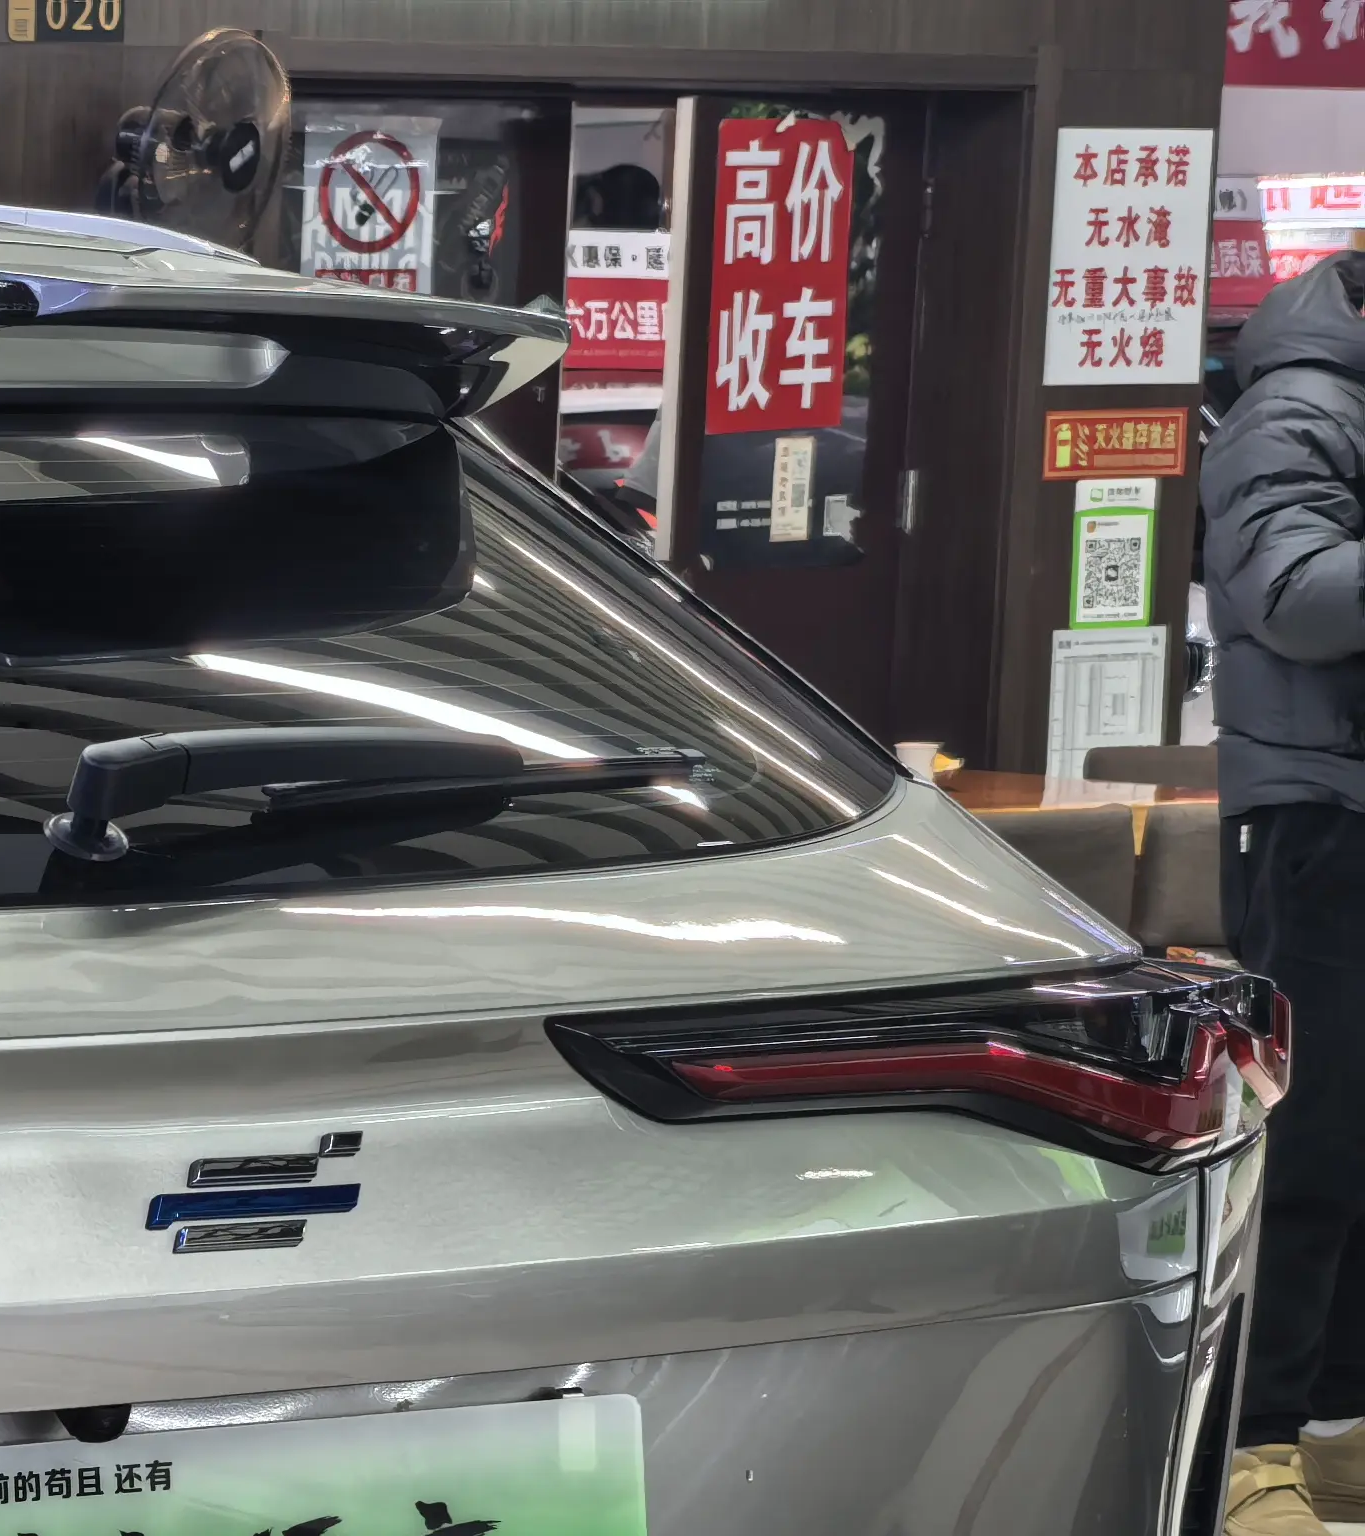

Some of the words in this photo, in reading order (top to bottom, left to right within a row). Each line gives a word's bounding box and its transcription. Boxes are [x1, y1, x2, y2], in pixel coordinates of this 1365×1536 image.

[1073, 144, 1191, 187] 本店承诺
[723, 140, 844, 265] 高价
[1085, 206, 1172, 248] 无水淹
[1052, 265, 1198, 308] 无重大事故
[716, 287, 834, 411] 收车
[1078, 327, 1165, 368] 无火烧
[114, 1460, 174, 1494] 还有
